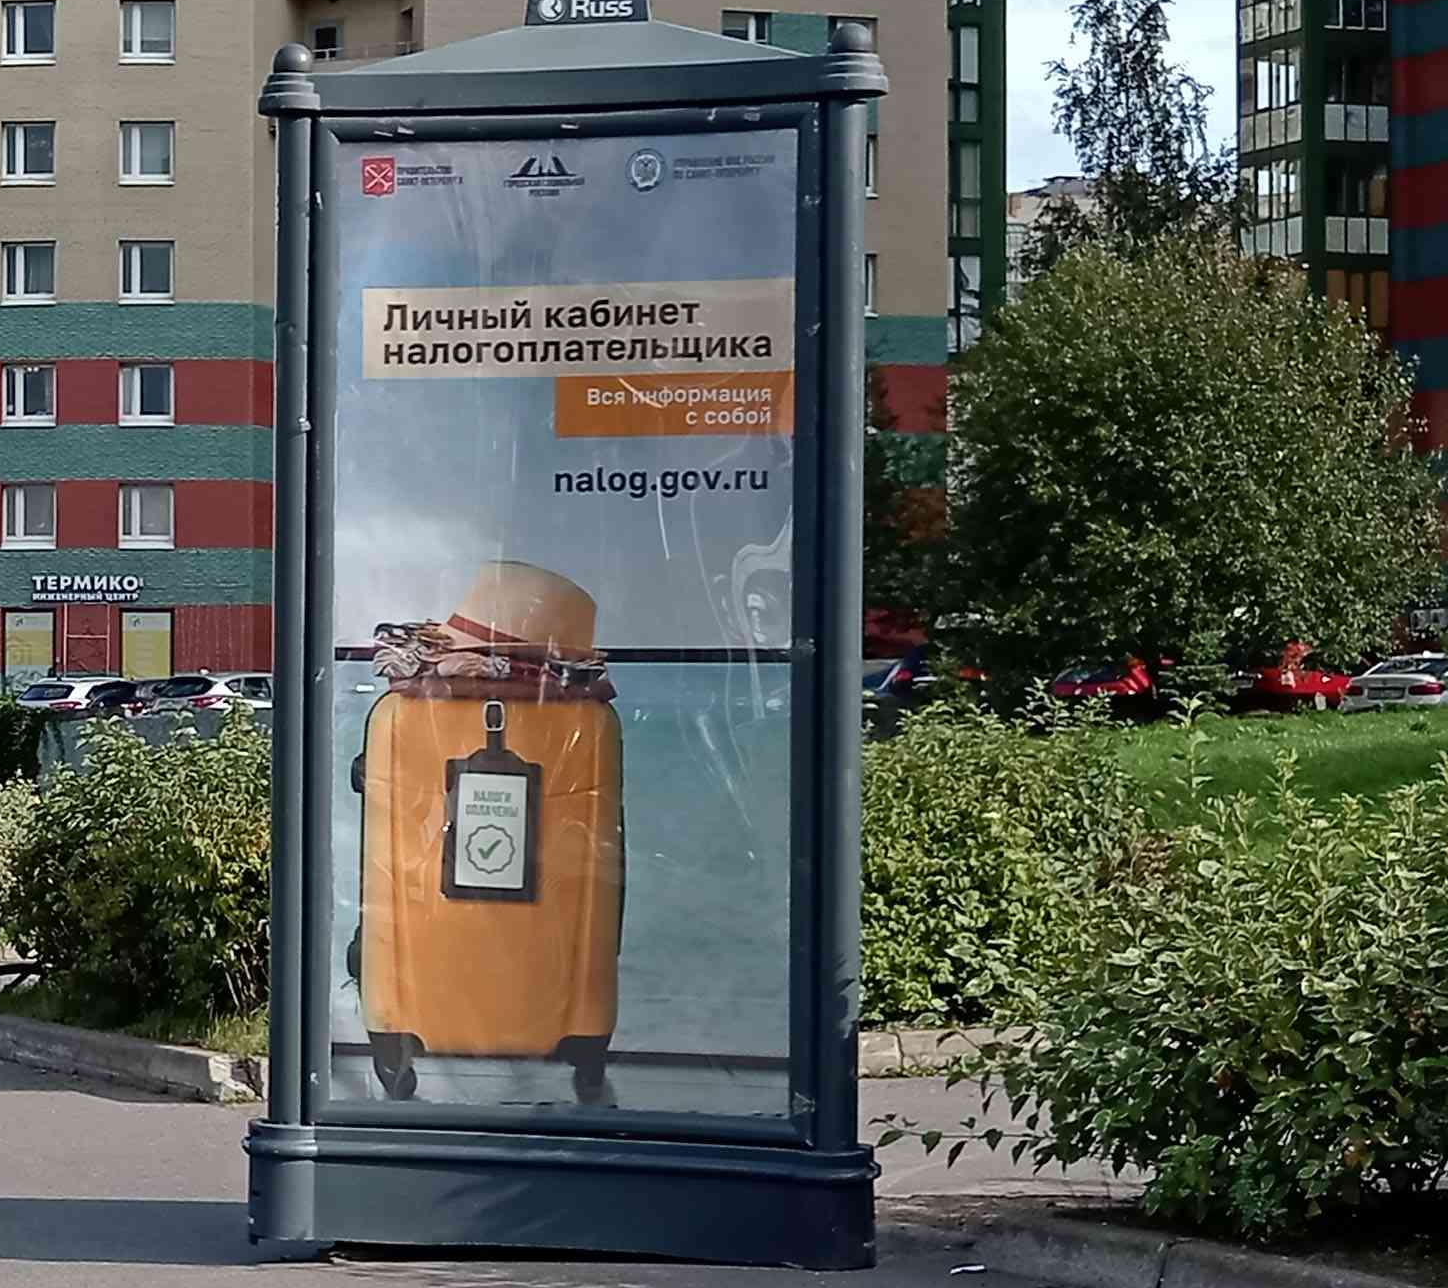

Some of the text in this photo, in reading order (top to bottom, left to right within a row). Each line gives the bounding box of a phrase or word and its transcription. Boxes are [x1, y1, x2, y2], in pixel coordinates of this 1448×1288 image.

[383, 299, 701, 332] Личный кабинет
[383, 334, 773, 366] налогоплательщика
[586, 386, 773, 407] Вся информация
[685, 406, 773, 425] с собой
[553, 467, 769, 499] nalog.gov.ru
[32, 575, 138, 591] ТЕРМИКО
